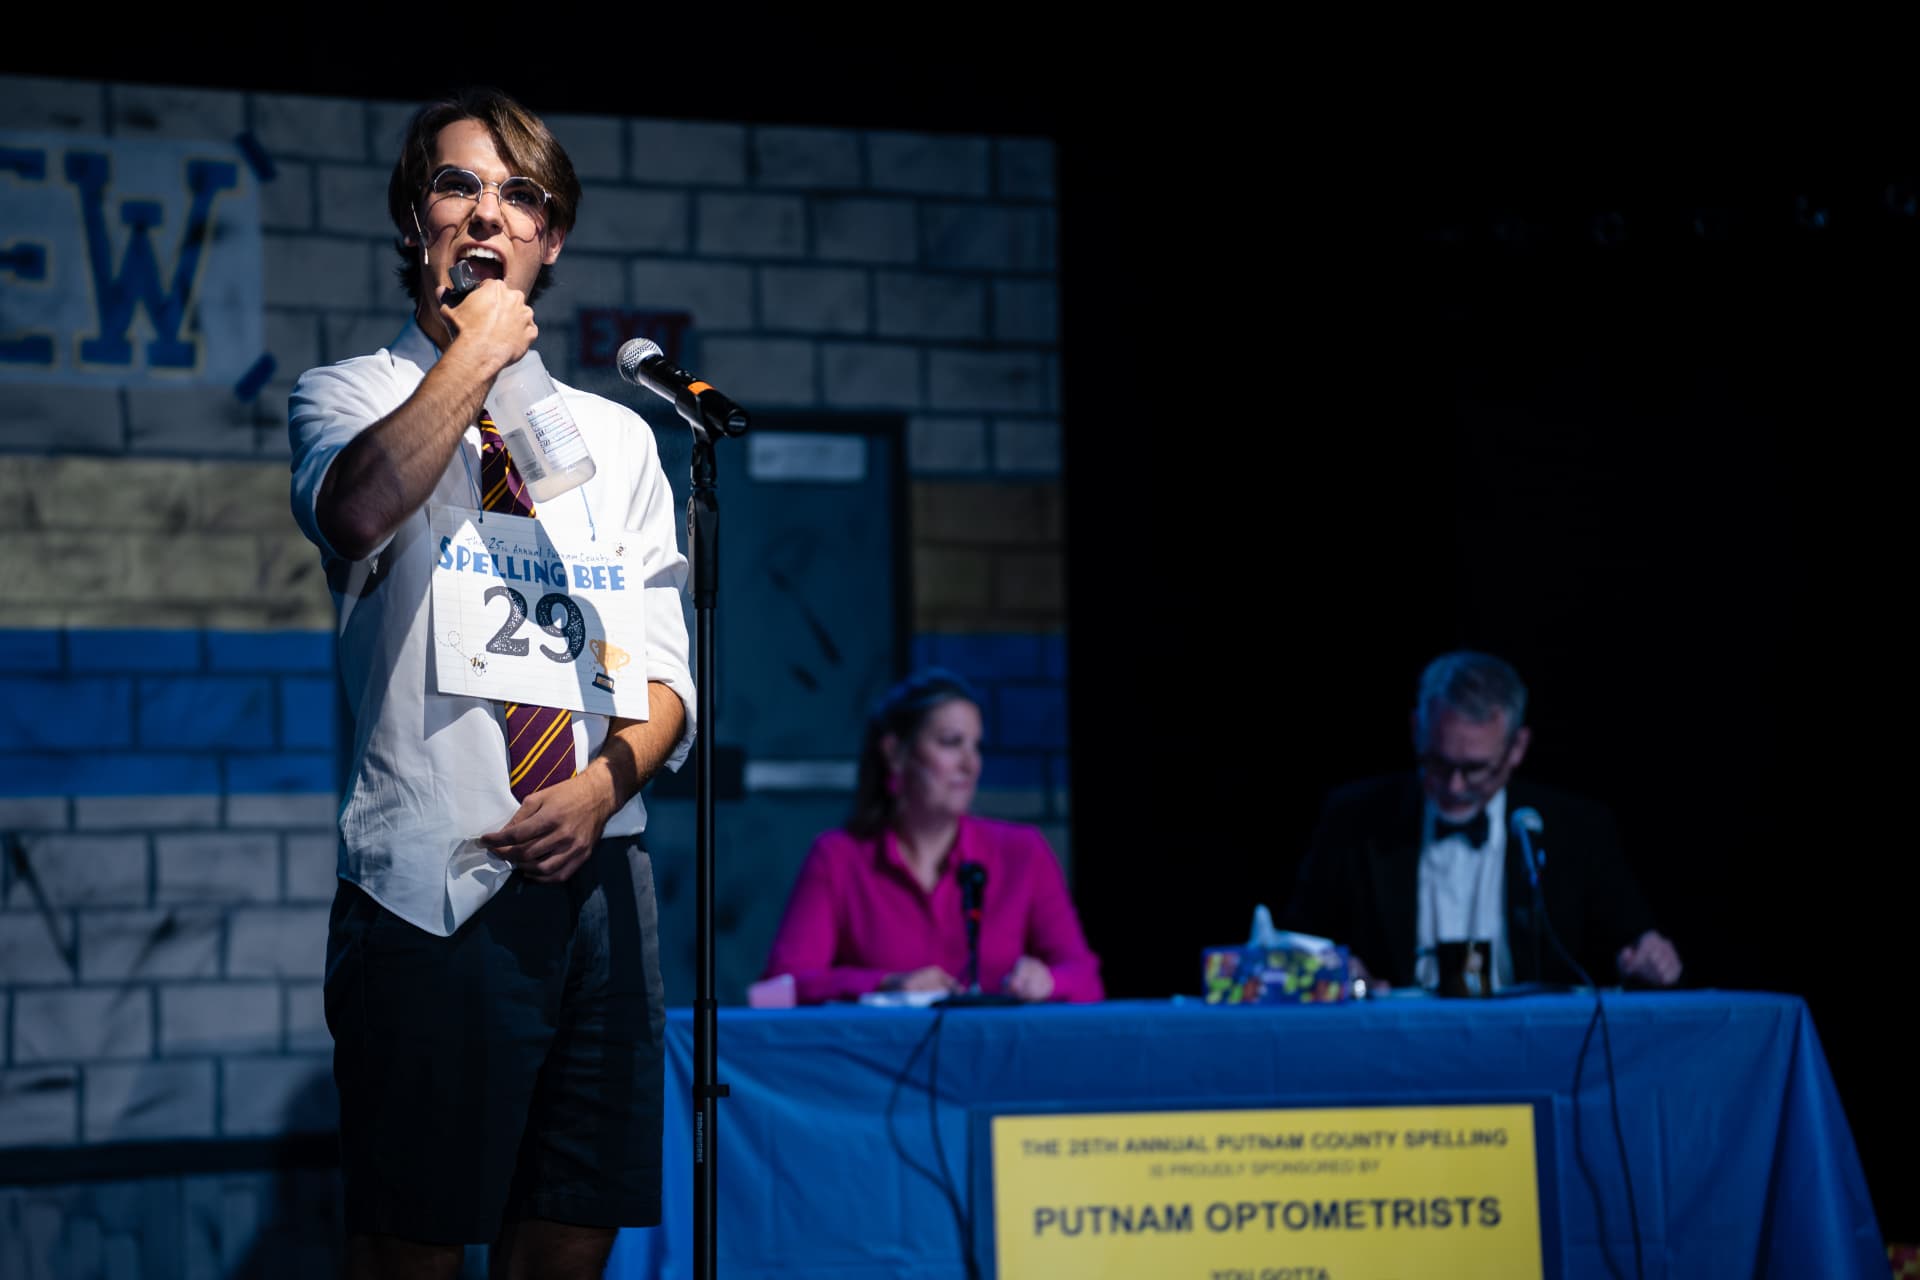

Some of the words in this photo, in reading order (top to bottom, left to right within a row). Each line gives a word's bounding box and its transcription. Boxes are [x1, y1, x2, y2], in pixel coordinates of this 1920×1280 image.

[438, 536, 567, 588] SPELLING
[573, 564, 625, 591] BEE
[484, 586, 586, 663] 29
[1022, 1138, 1059, 1156] THE
[1125, 1134, 1208, 1153] ANNUAL
[1216, 1133, 1305, 1151] PUTNAM
[1311, 1131, 1397, 1149] COUNTY
[1405, 1128, 1508, 1147] SPELLING
[1034, 1203, 1193, 1237] PUTNAM
[1205, 1196, 1503, 1234] OPTOMETRISTS
